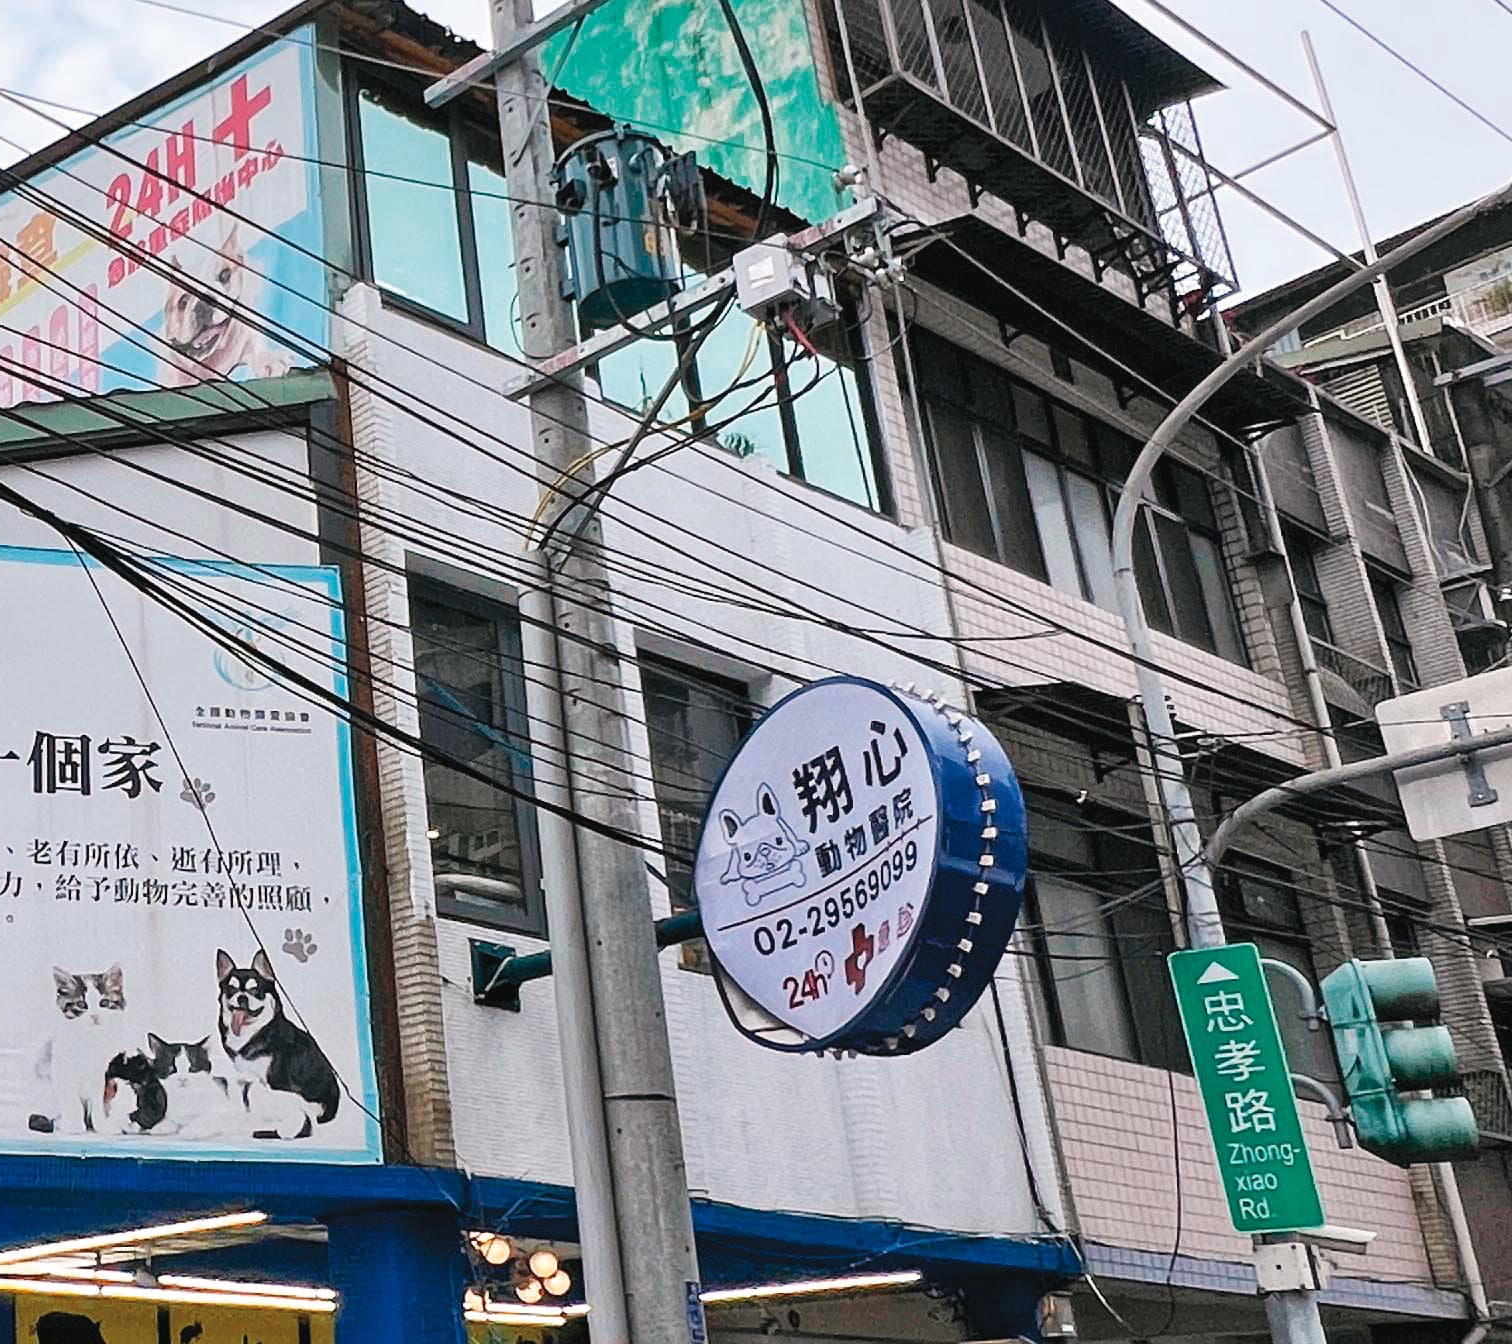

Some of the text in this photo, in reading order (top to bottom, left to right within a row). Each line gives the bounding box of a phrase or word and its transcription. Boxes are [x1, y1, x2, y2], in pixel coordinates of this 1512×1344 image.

[106, 118, 196, 246] 24H
[792, 720, 908, 834] 翔心
[814, 787, 912, 879] 動物醫院
[753, 841, 918, 957] 02-29569099
[1204, 990, 1276, 1134] 忠孝路
[1228, 1142, 1301, 1167] Zhong-
[1234, 1171, 1278, 1192] xiao
